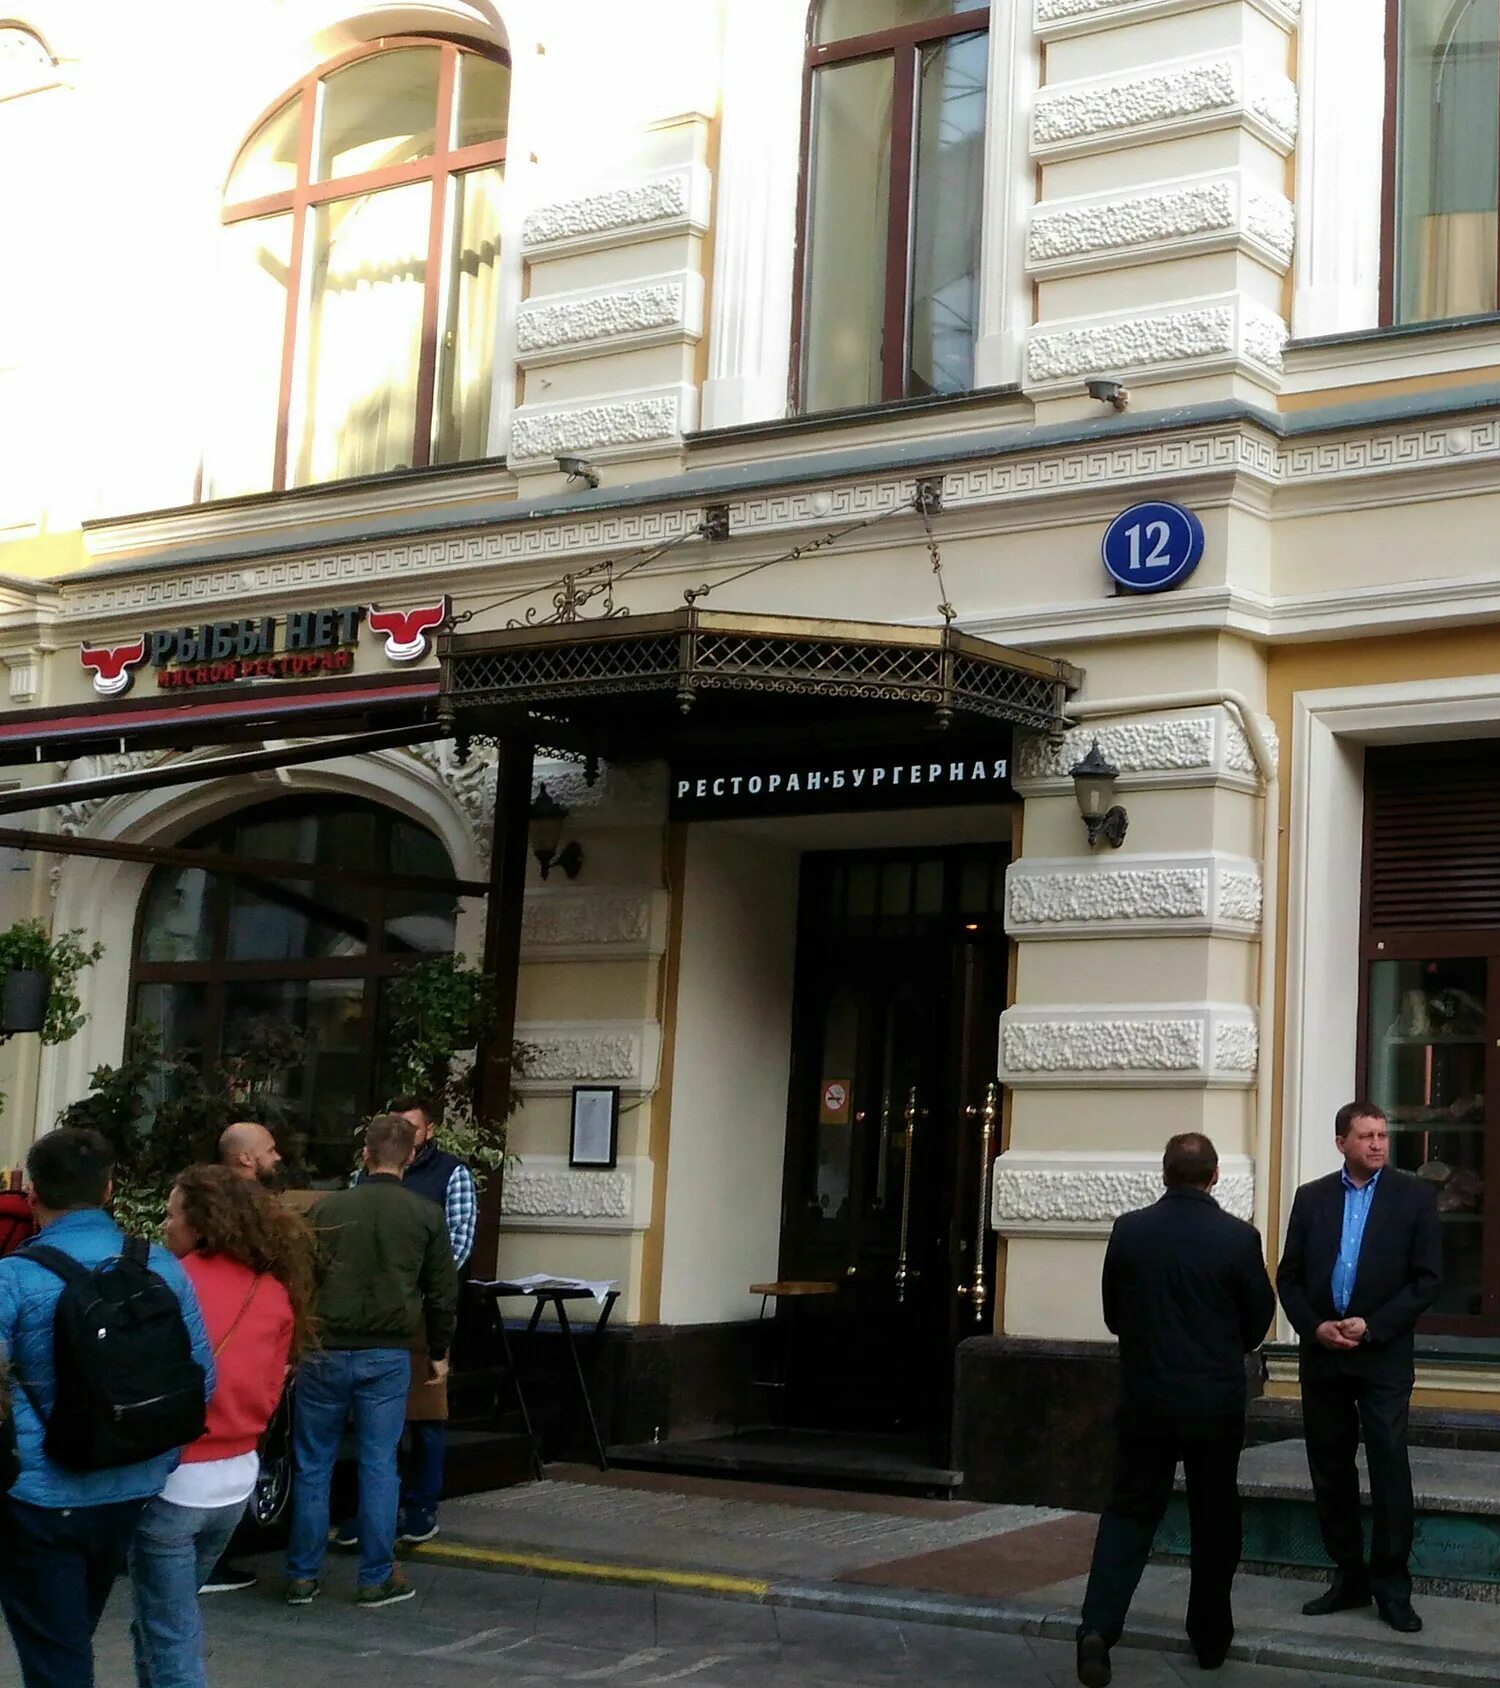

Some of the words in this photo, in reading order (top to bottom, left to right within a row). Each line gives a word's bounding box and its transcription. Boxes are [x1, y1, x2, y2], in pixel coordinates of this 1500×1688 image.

[1125, 521, 1170, 569] 12
[151, 617, 276, 667] РЫБЫ
[285, 607, 360, 649] НЕТ
[241, 651, 352, 677] РЕСТОРАН
